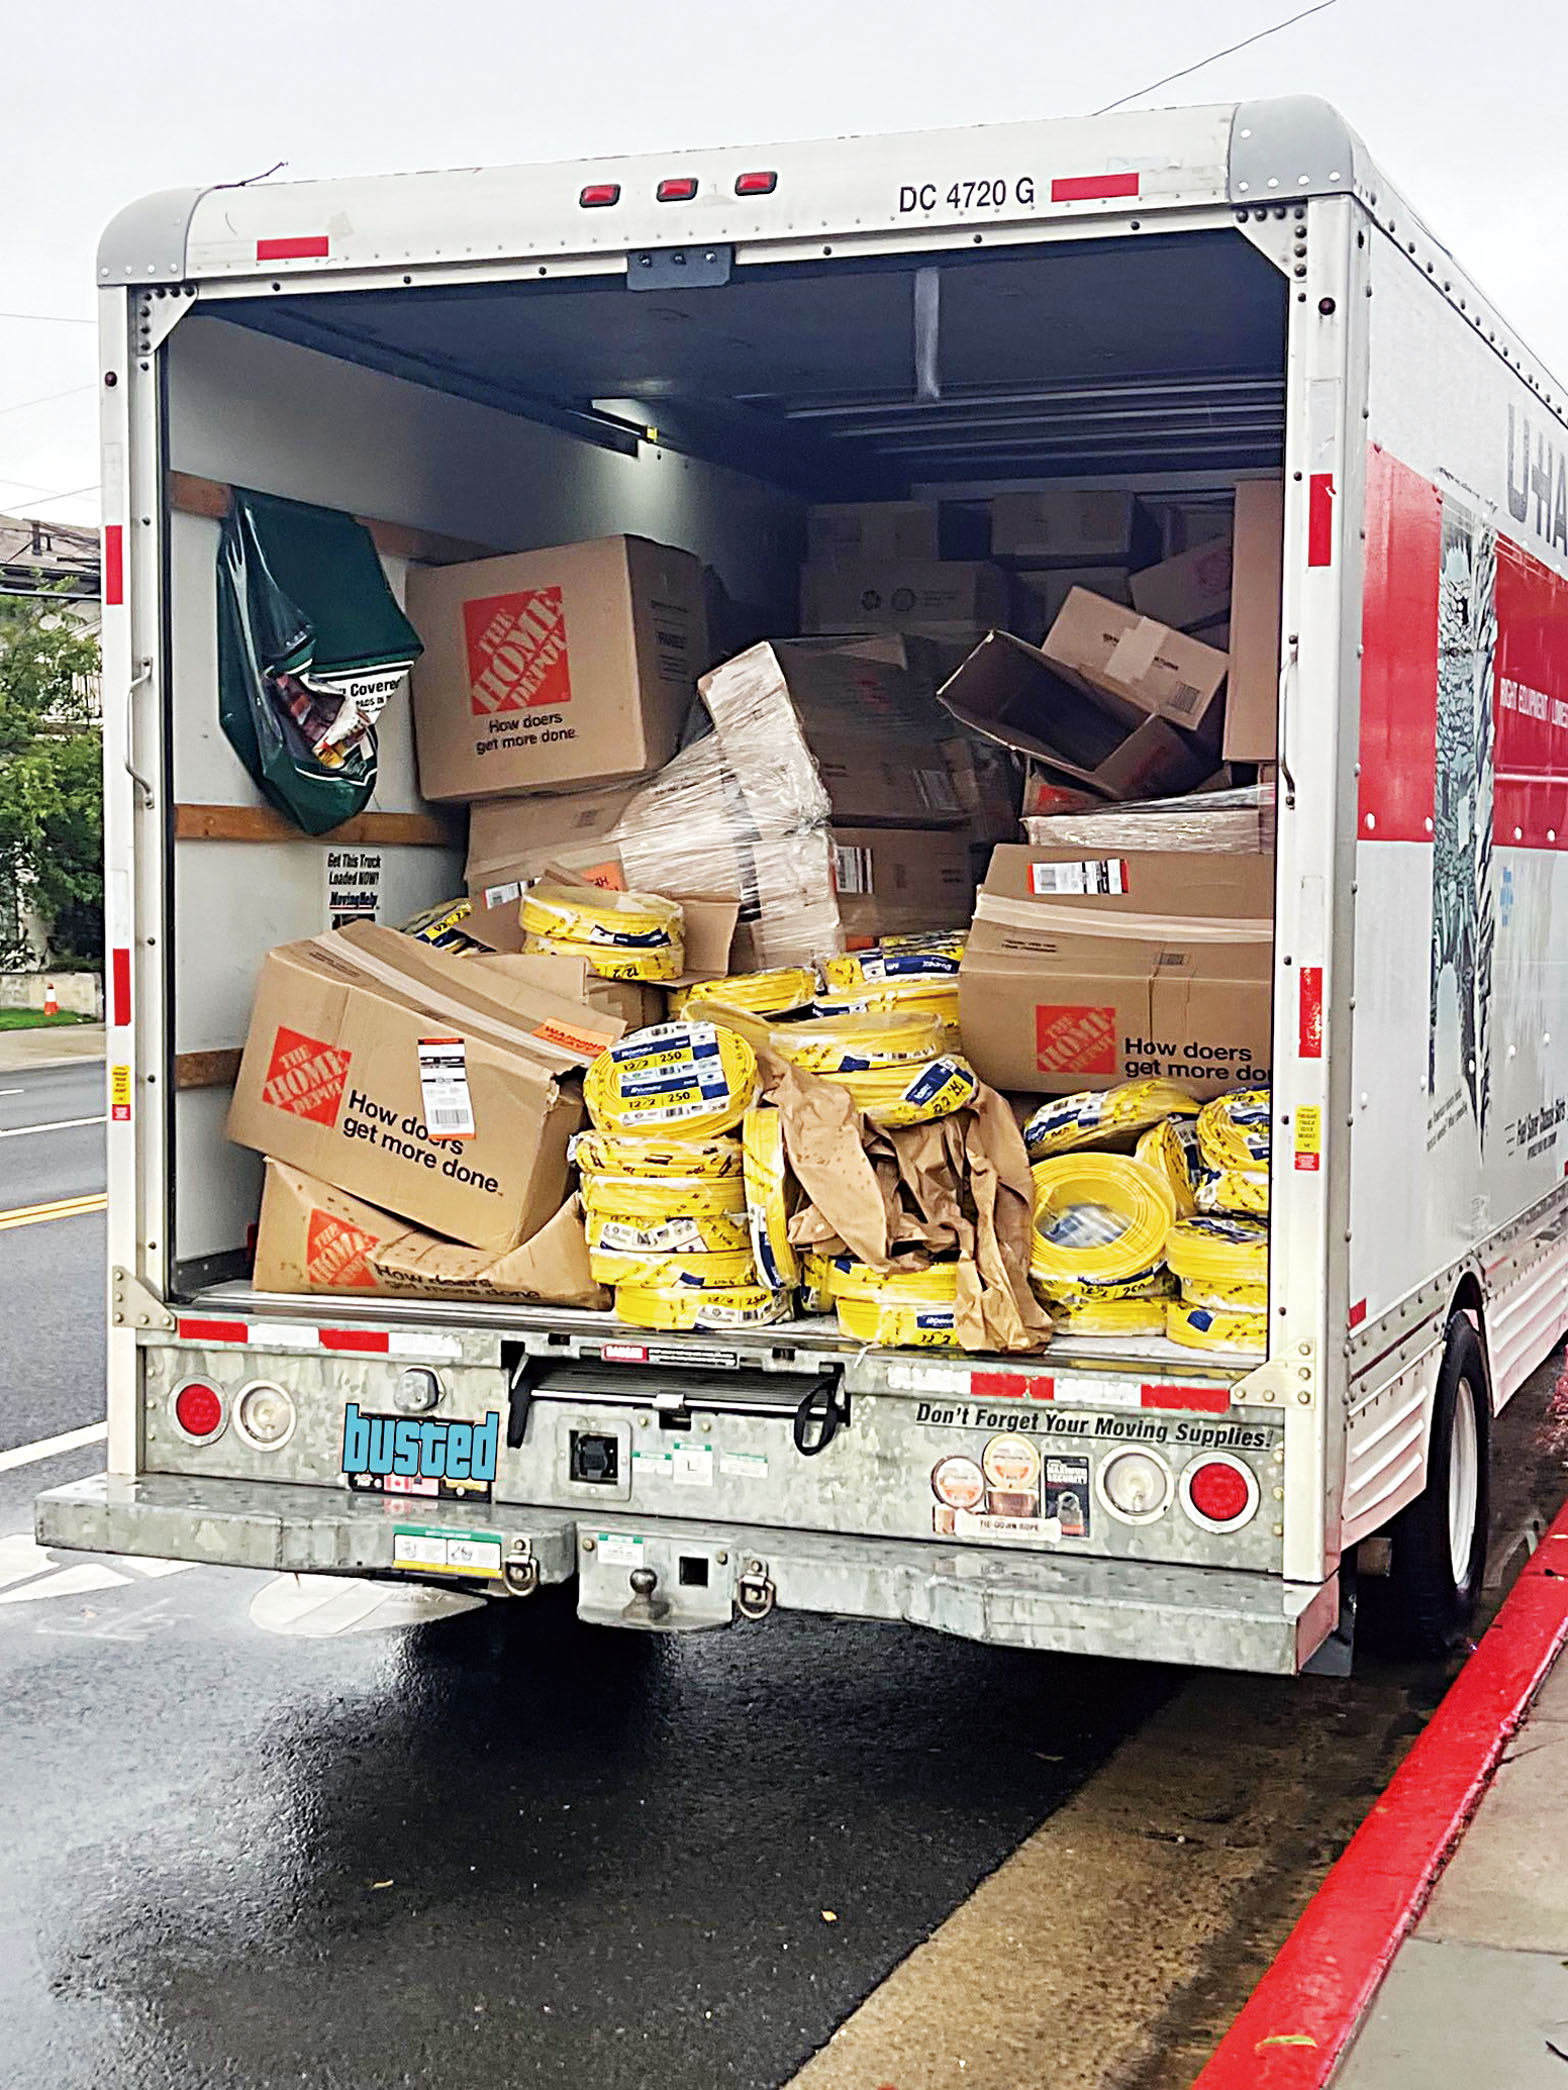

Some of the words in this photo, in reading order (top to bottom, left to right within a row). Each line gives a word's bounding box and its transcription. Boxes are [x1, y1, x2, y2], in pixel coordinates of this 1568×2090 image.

[899, 185, 937, 212] DC
[945, 179, 1007, 208] 4720
[1015, 177, 1035, 204] G
[475, 608, 516, 654] THE
[472, 588, 564, 713] HOME
[489, 718, 520, 734] How
[522, 712, 564, 729] doers
[475, 738, 499, 755] get
[502, 734, 538, 749] more
[327, 853, 341, 868] Get
[342, 854, 359, 868] This
[360, 853, 381, 868] Truck
[1038, 1006, 1114, 1070] HOME
[1125, 1037, 1177, 1056] How
[1183, 1041, 1252, 1061] doers
[279, 1044, 312, 1069] THE
[659, 1050, 682, 1063] 250
[265, 1049, 351, 1104] HOME
[1124, 1059, 1161, 1078] get
[1168, 1062, 1229, 1080] more
[348, 1089, 398, 1126] How
[667, 1091, 691, 1103] 250
[342, 1116, 378, 1144] get
[381, 1133, 438, 1169] more
[442, 1158, 499, 1193] done
[373, 1262, 423, 1284] How
[916, 1403, 970, 1425] Don't
[975, 1409, 1040, 1432] Forget
[1046, 1414, 1090, 1434] Your
[1095, 1418, 1168, 1443] Moving
[1175, 1423, 1274, 1448] Supplies!
